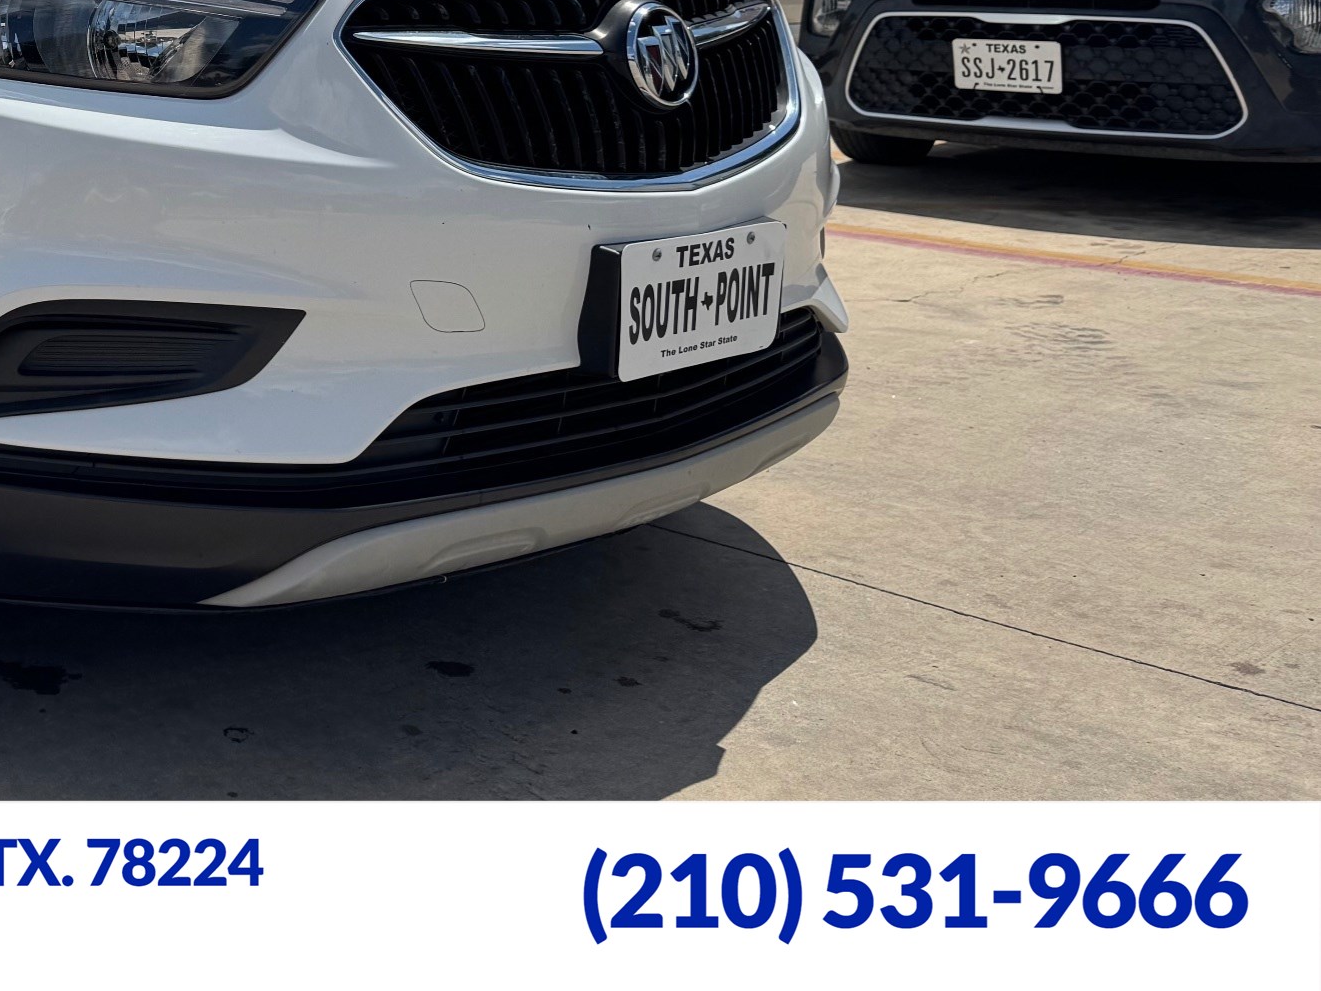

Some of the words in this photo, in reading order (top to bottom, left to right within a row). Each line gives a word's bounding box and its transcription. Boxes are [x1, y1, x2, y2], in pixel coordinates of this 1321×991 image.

[985, 43, 1027, 54] TEXAS
[961, 56, 995, 79] SSJ
[1006, 58, 1055, 83] 2617
[676, 237, 735, 268] TEXAS
[629, 276, 700, 346] SOUTH
[714, 262, 775, 326] POINT
[660, 348, 677, 358] The
[678, 344, 698, 354] Lone
[699, 340, 716, 349] Star
[717, 335, 738, 345] State
